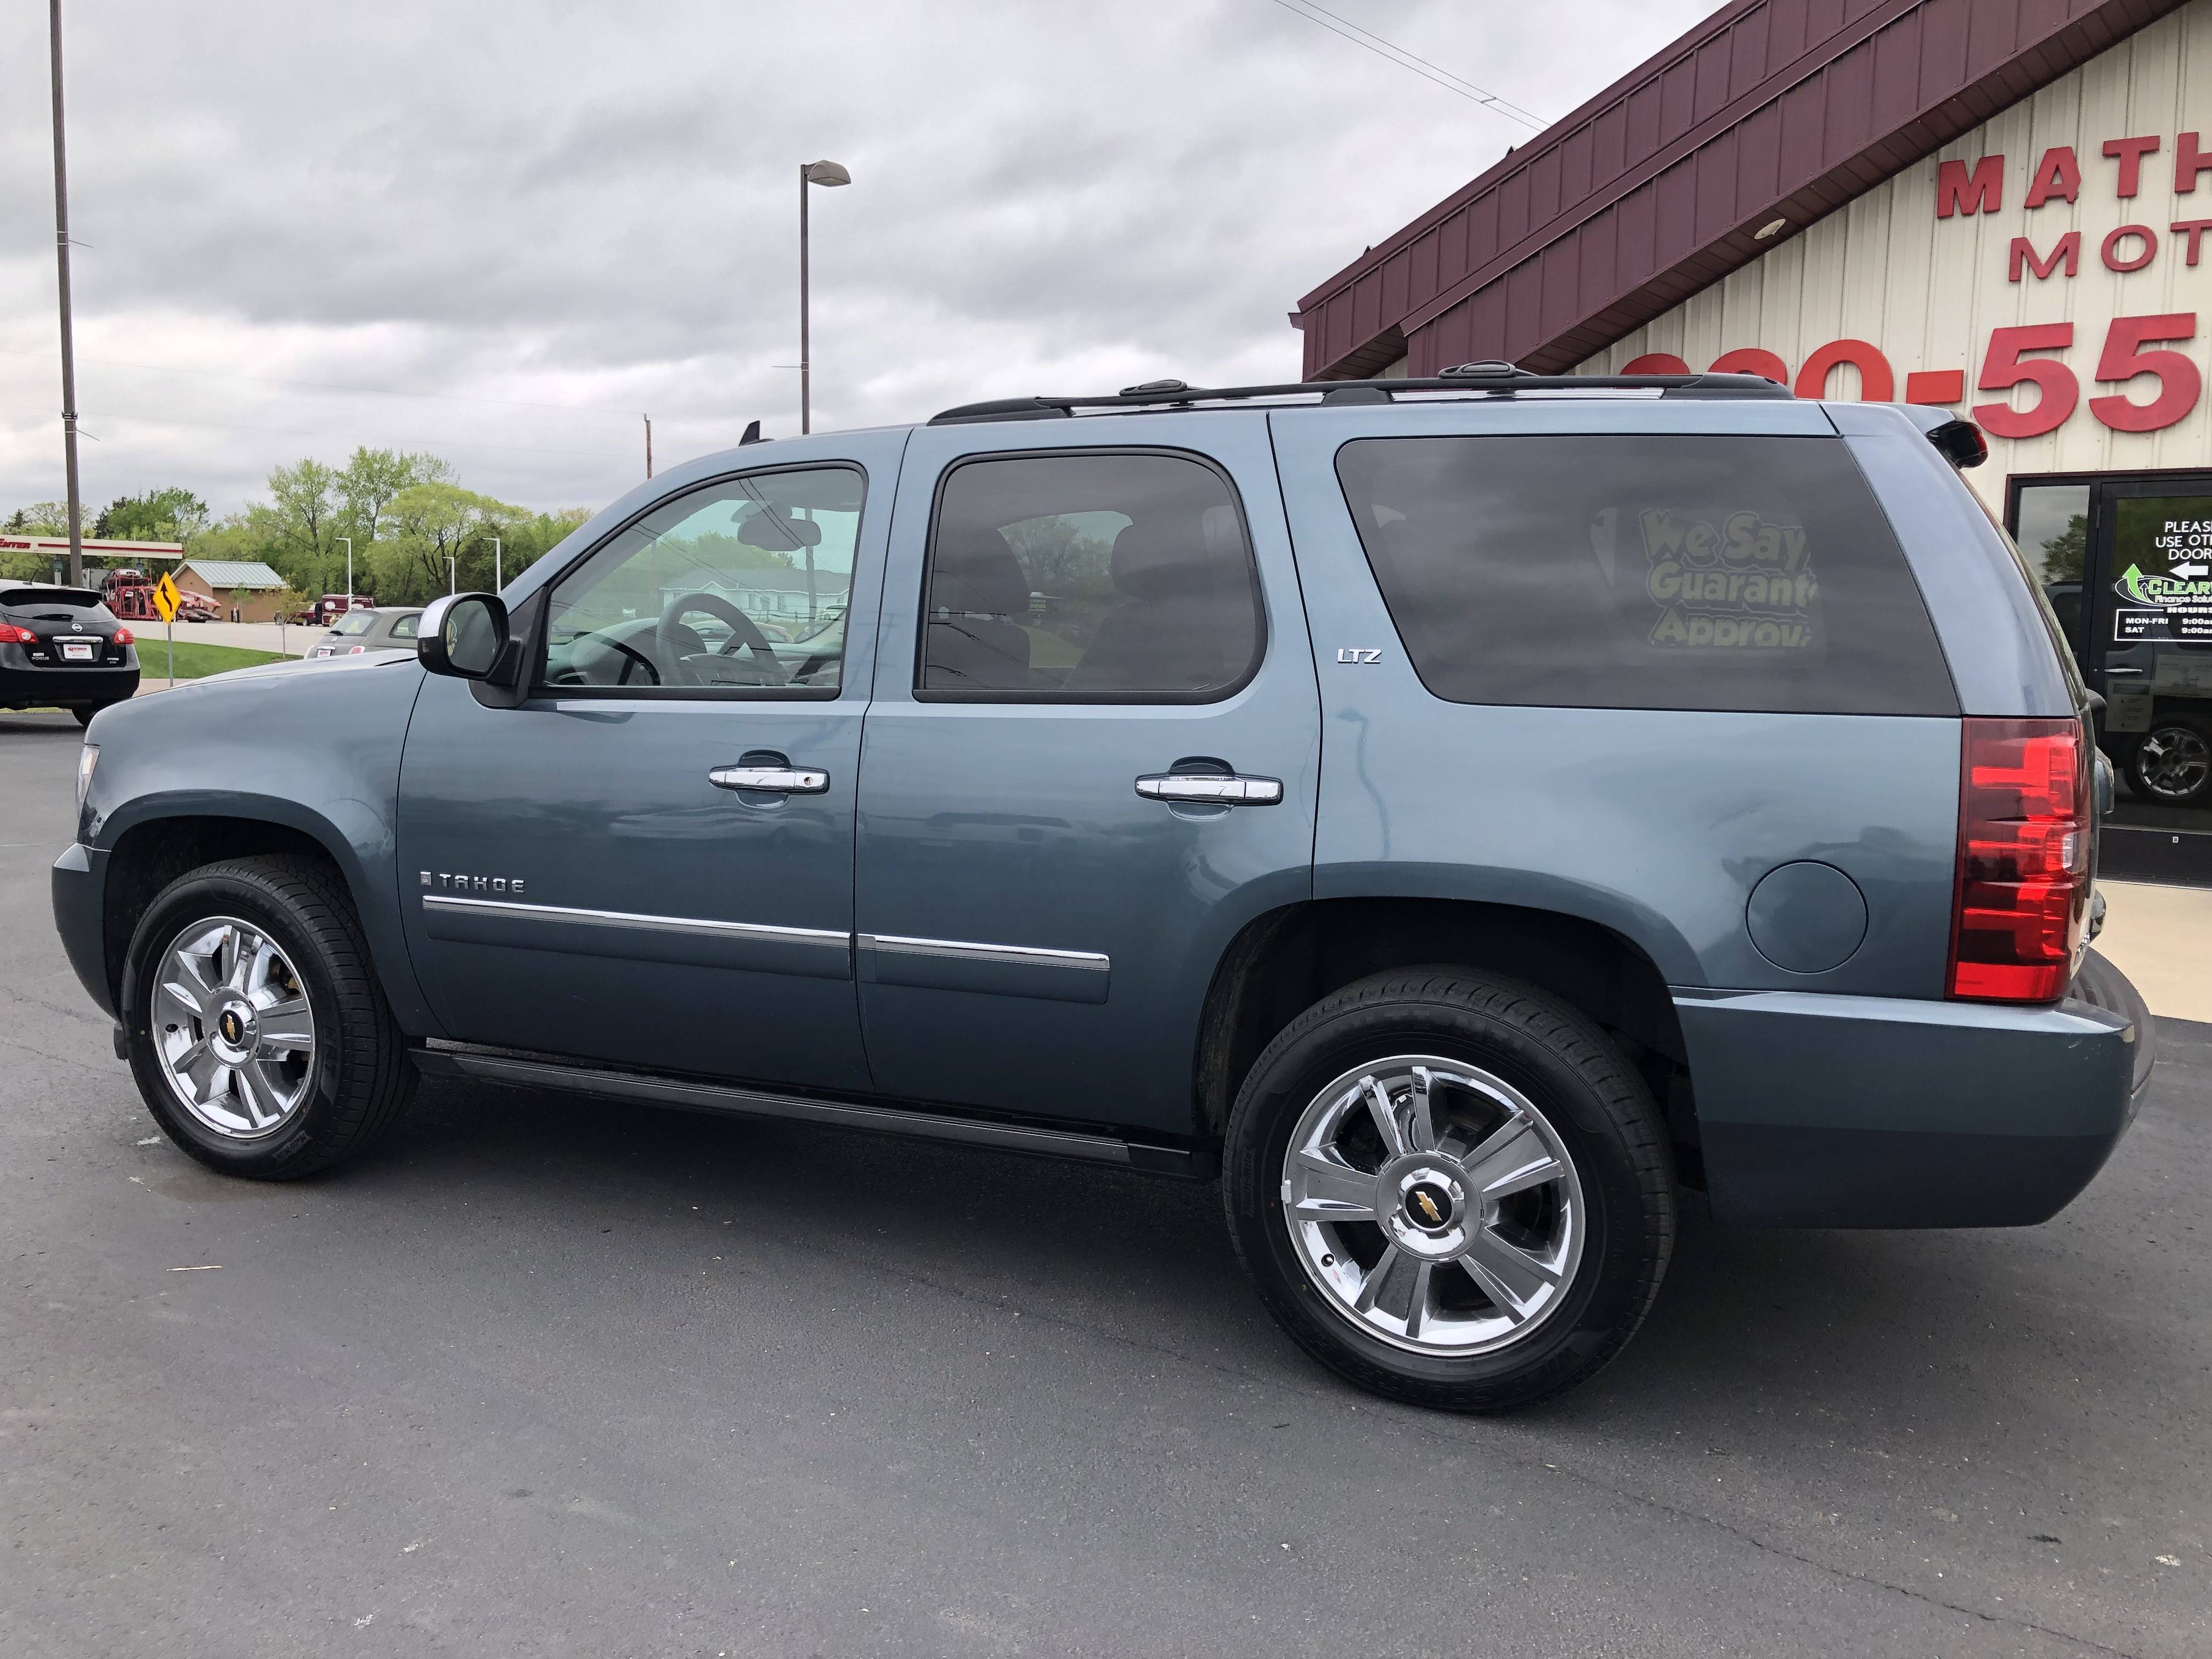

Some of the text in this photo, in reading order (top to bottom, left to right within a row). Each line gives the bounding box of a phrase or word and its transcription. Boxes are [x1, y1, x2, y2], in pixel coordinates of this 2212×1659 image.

[2008, 219, 2212, 283] MOT
[2165, 521, 2212, 533] PLEAS
[2155, 535, 2183, 548] USE
[2168, 548, 2212, 560] DOOR
[1650, 561, 1817, 607] Guarant
[2148, 579, 2212, 595] CLEAR
[1651, 606, 1813, 648] Approv
[1338, 648, 1381, 664] LTZ
[439, 873, 524, 894] TAHOE
